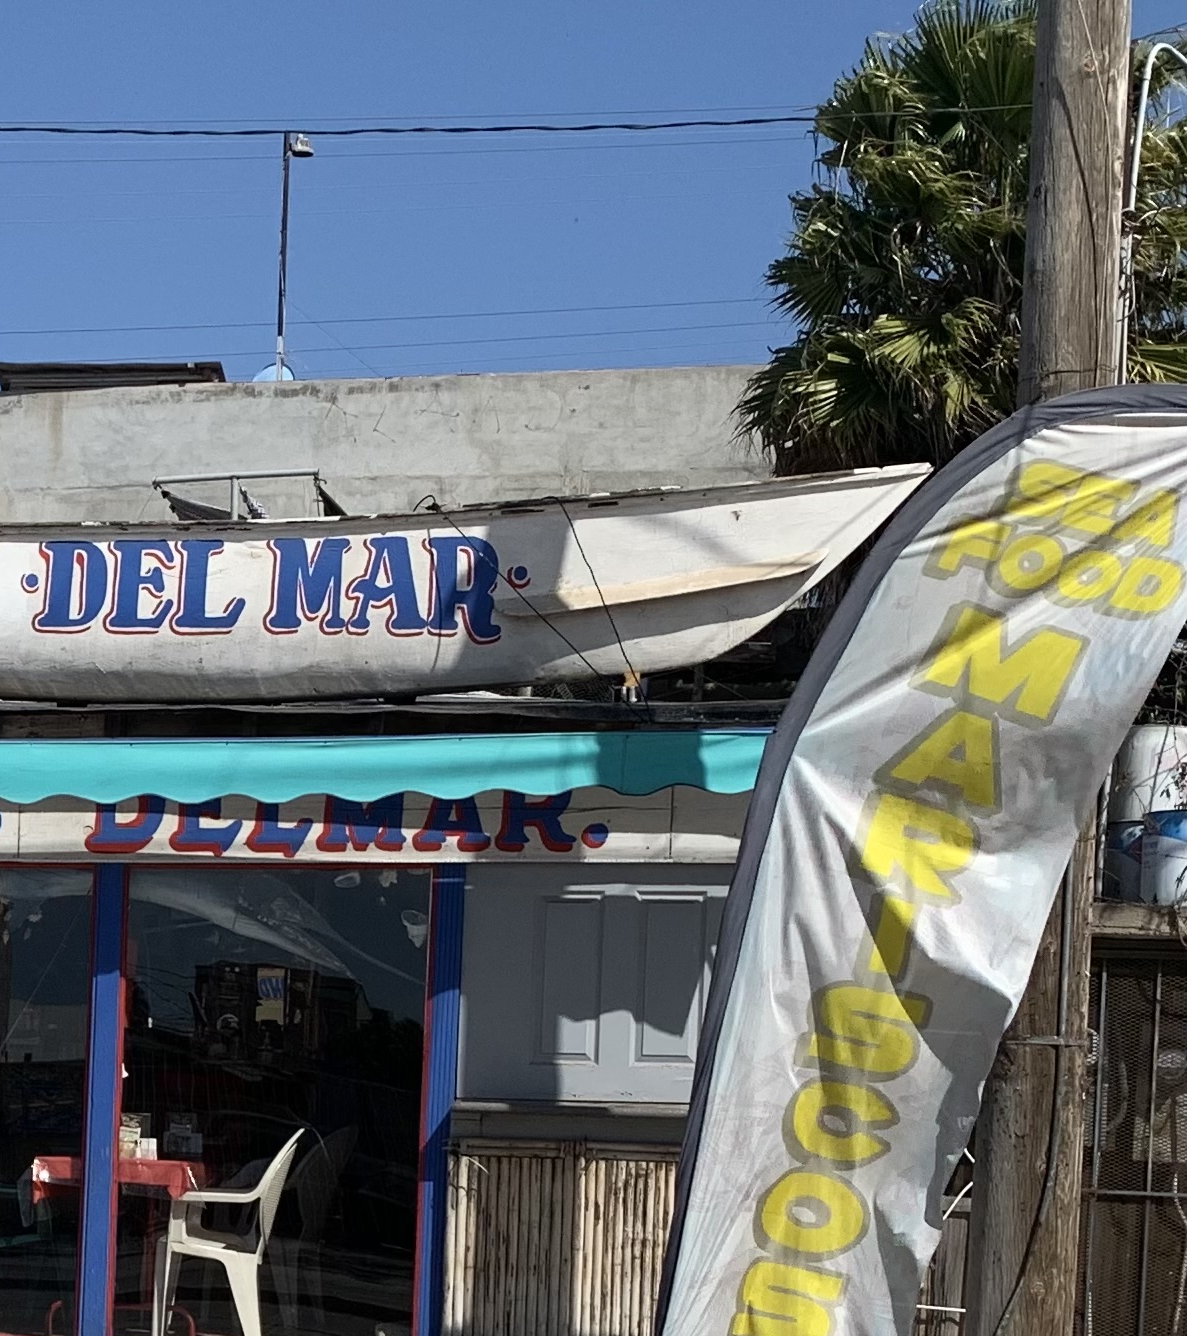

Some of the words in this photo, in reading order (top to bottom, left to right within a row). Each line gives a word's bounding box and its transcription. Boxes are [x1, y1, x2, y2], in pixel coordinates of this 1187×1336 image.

[1007, 458, 1183, 550] SEA
[32, 537, 244, 635] DEL
[923, 514, 1187, 620] FOOD
